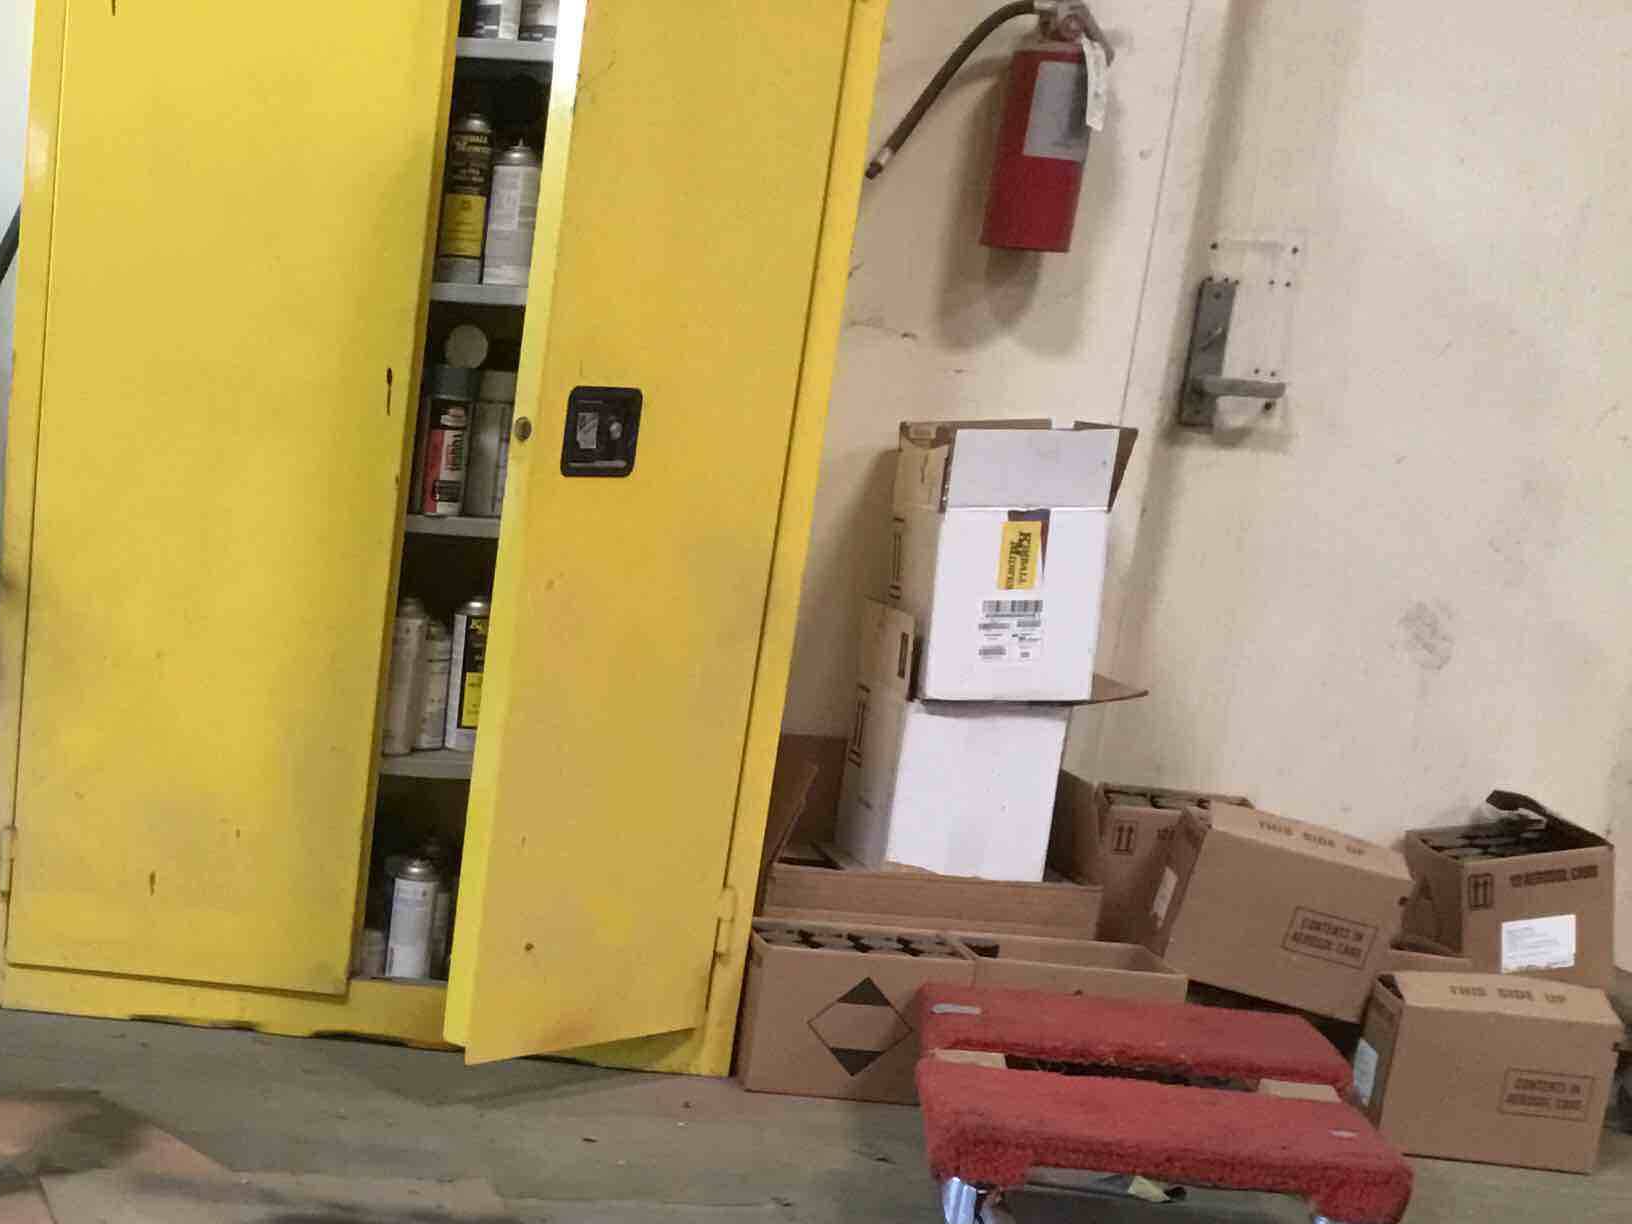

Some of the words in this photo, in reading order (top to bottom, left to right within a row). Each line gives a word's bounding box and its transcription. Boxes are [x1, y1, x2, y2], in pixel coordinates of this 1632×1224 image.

[1257, 819, 1295, 836] THIS
[1302, 831, 1336, 849] SIDE
[1448, 983, 1489, 999] THIS
[1495, 987, 1536, 1003] SIDE
